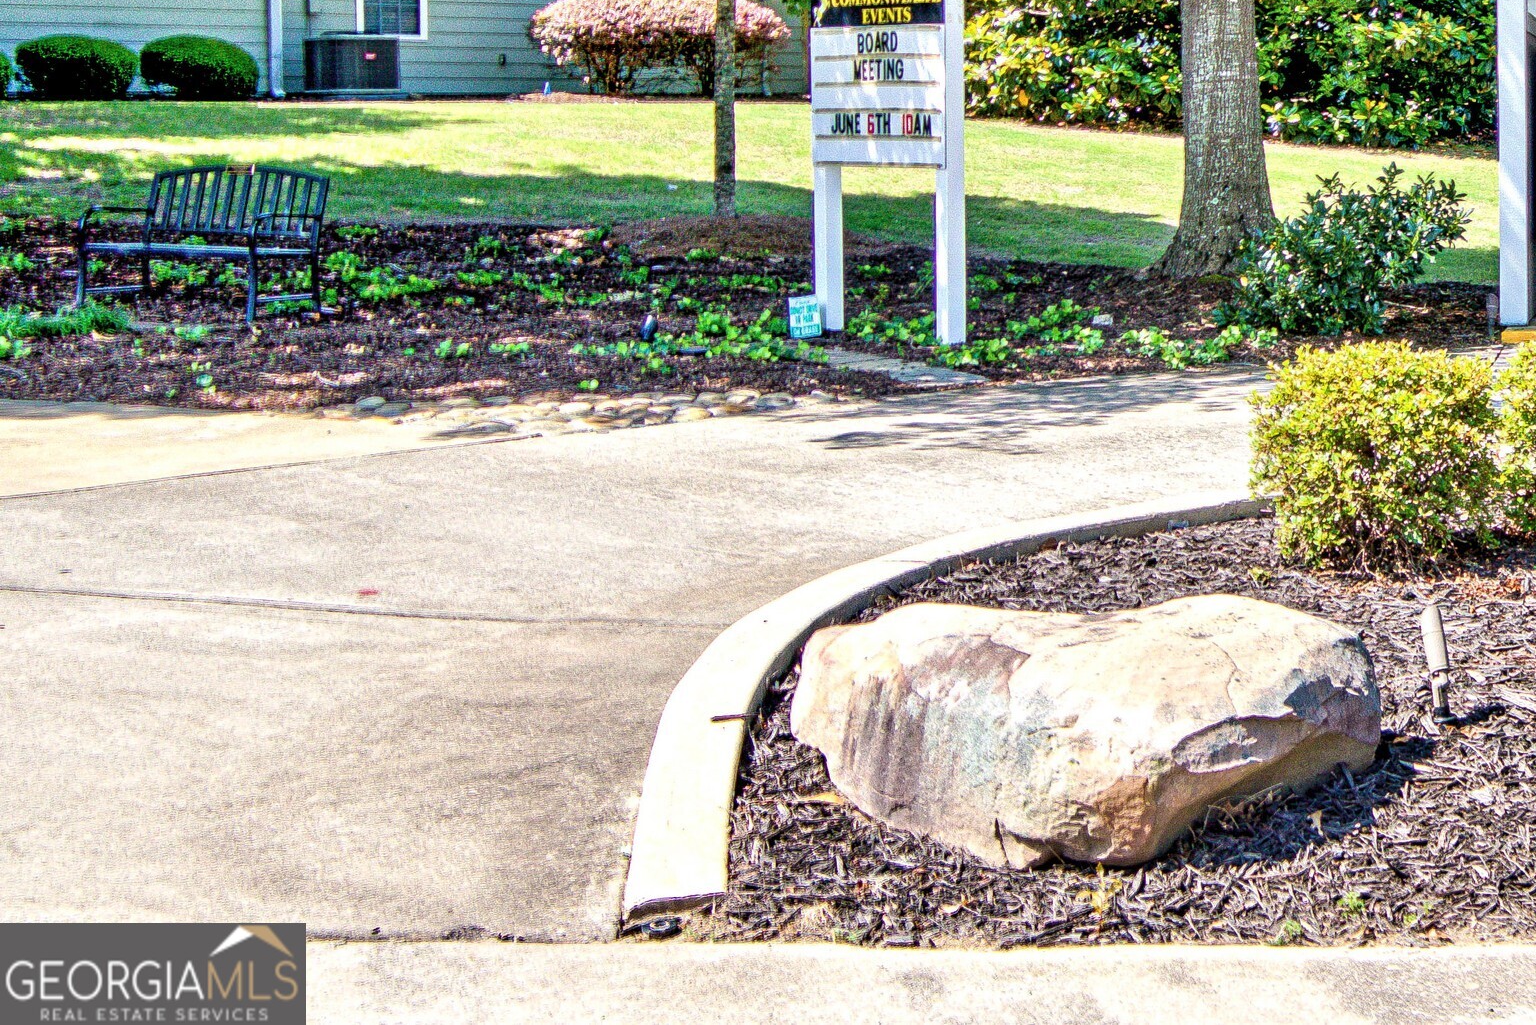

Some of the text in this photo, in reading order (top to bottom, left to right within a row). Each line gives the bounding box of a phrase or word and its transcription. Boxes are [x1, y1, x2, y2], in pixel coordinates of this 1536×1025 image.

[862, 6, 912, 24] EVENTS
[857, 31, 898, 53] BOARD
[854, 58, 904, 81] MEETING
[831, 113, 932, 135] JUNE 6TH 10AM
